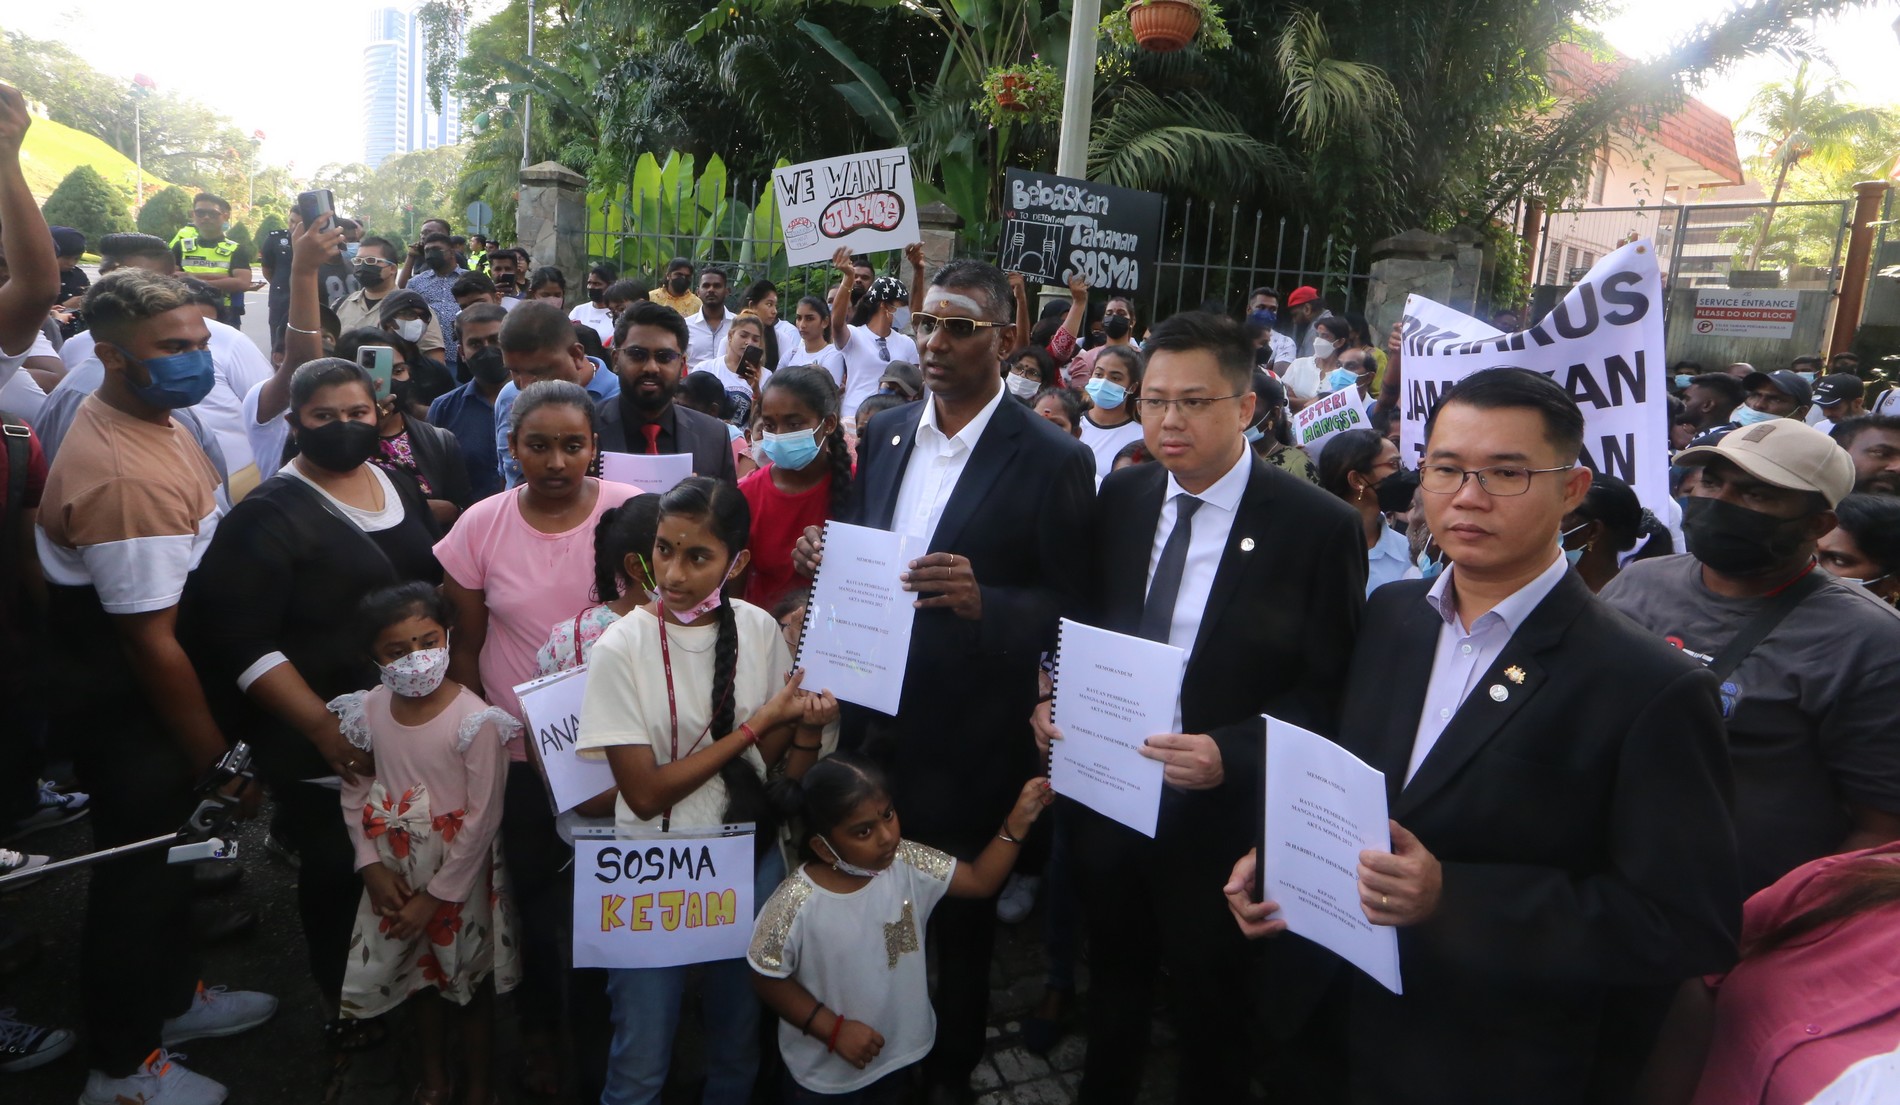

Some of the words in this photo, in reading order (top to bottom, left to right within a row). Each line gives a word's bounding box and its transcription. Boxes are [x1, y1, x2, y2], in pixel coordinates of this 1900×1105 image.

[776, 168, 815, 206] WE
[822, 155, 906, 198] WANT
[1005, 210, 1016, 218] NO
[1020, 212, 1029, 220] TO
[1064, 214, 1139, 252] Tahanan
[1062, 249, 1139, 291] SOSMA
[1699, 298, 1738, 306] SERVICE
[1741, 300, 1795, 308] ENTRANCE
[1299, 392, 1347, 427] ISTERI
[1303, 408, 1360, 444] MANGSA
[1095, 664, 1133, 678] MEMORANDUM
[1306, 770, 1346, 794] MEMORANDUM
[1300, 798, 1322, 811] RAYUAN
[1307, 821, 1322, 831] AKTA
[1322, 828, 1342, 840] SOSMA
[595, 845, 716, 884] SOSMA
[600, 888, 737, 932] KEJAM
